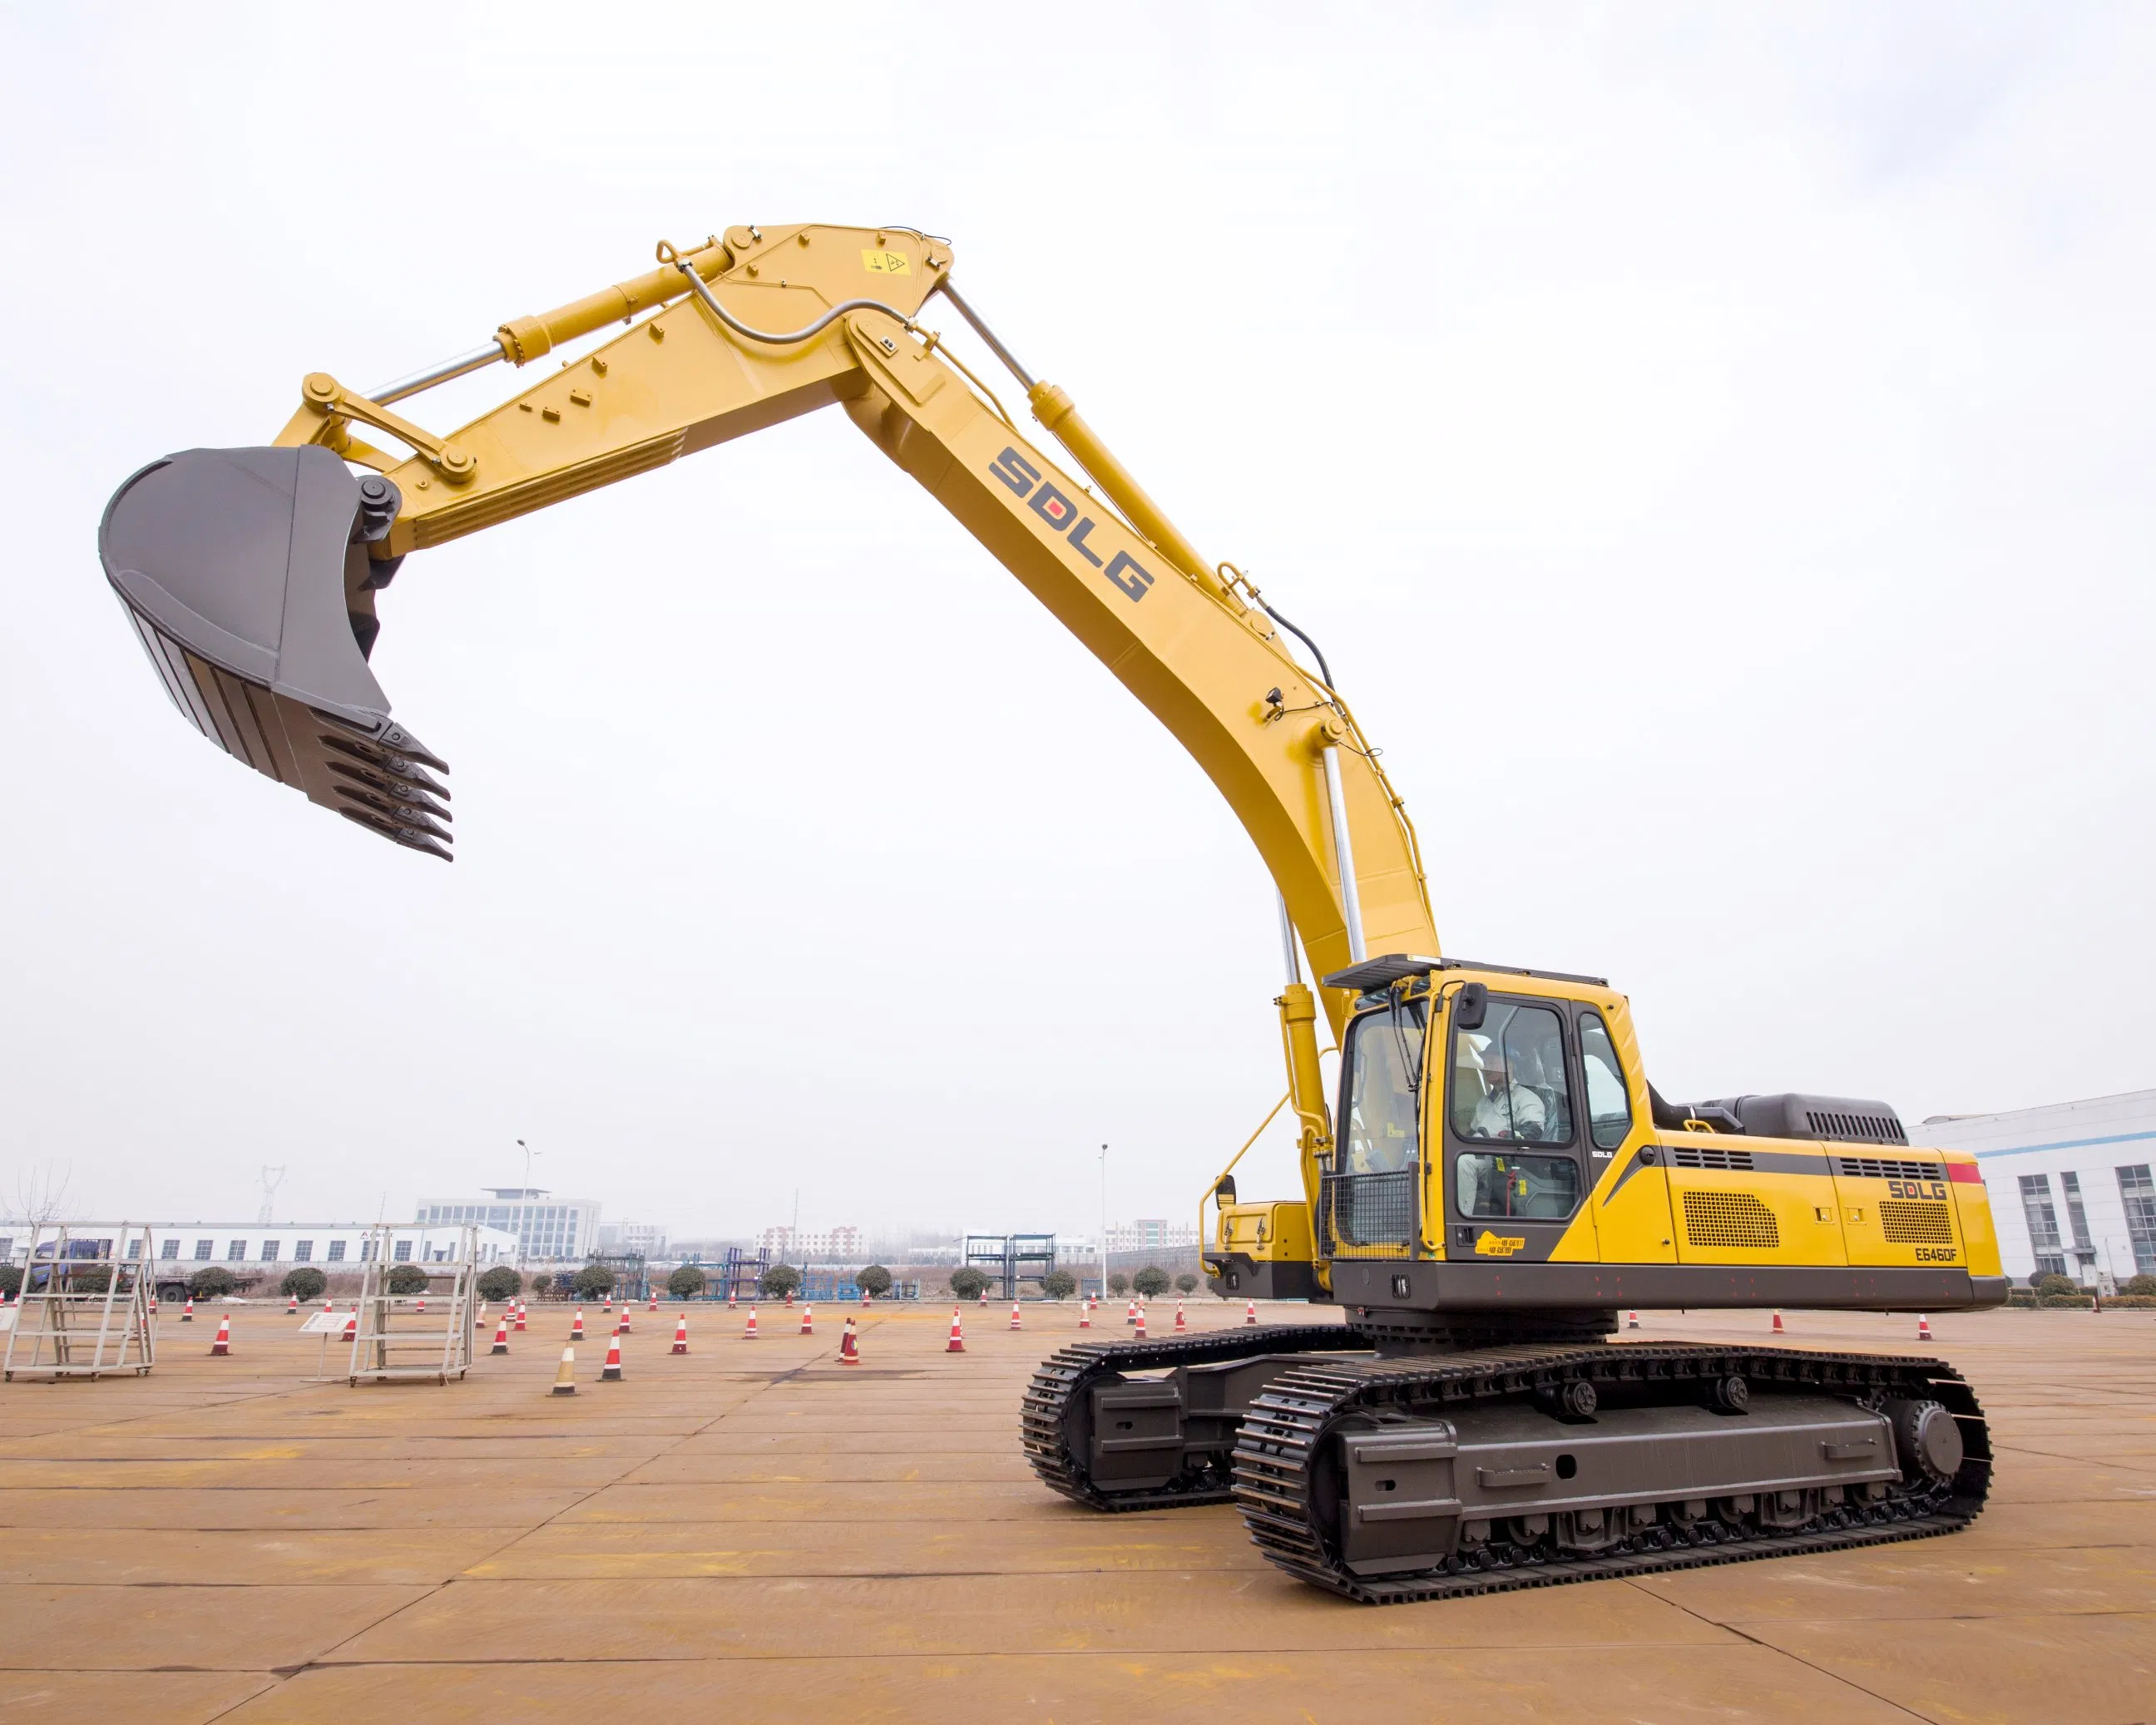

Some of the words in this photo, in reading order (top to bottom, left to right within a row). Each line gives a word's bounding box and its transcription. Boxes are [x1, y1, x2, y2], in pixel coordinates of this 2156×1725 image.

[988, 447, 1155, 603] SDLG
[1888, 1181, 1947, 1200] SDLG
[1915, 1248, 1957, 1261] E6460F
